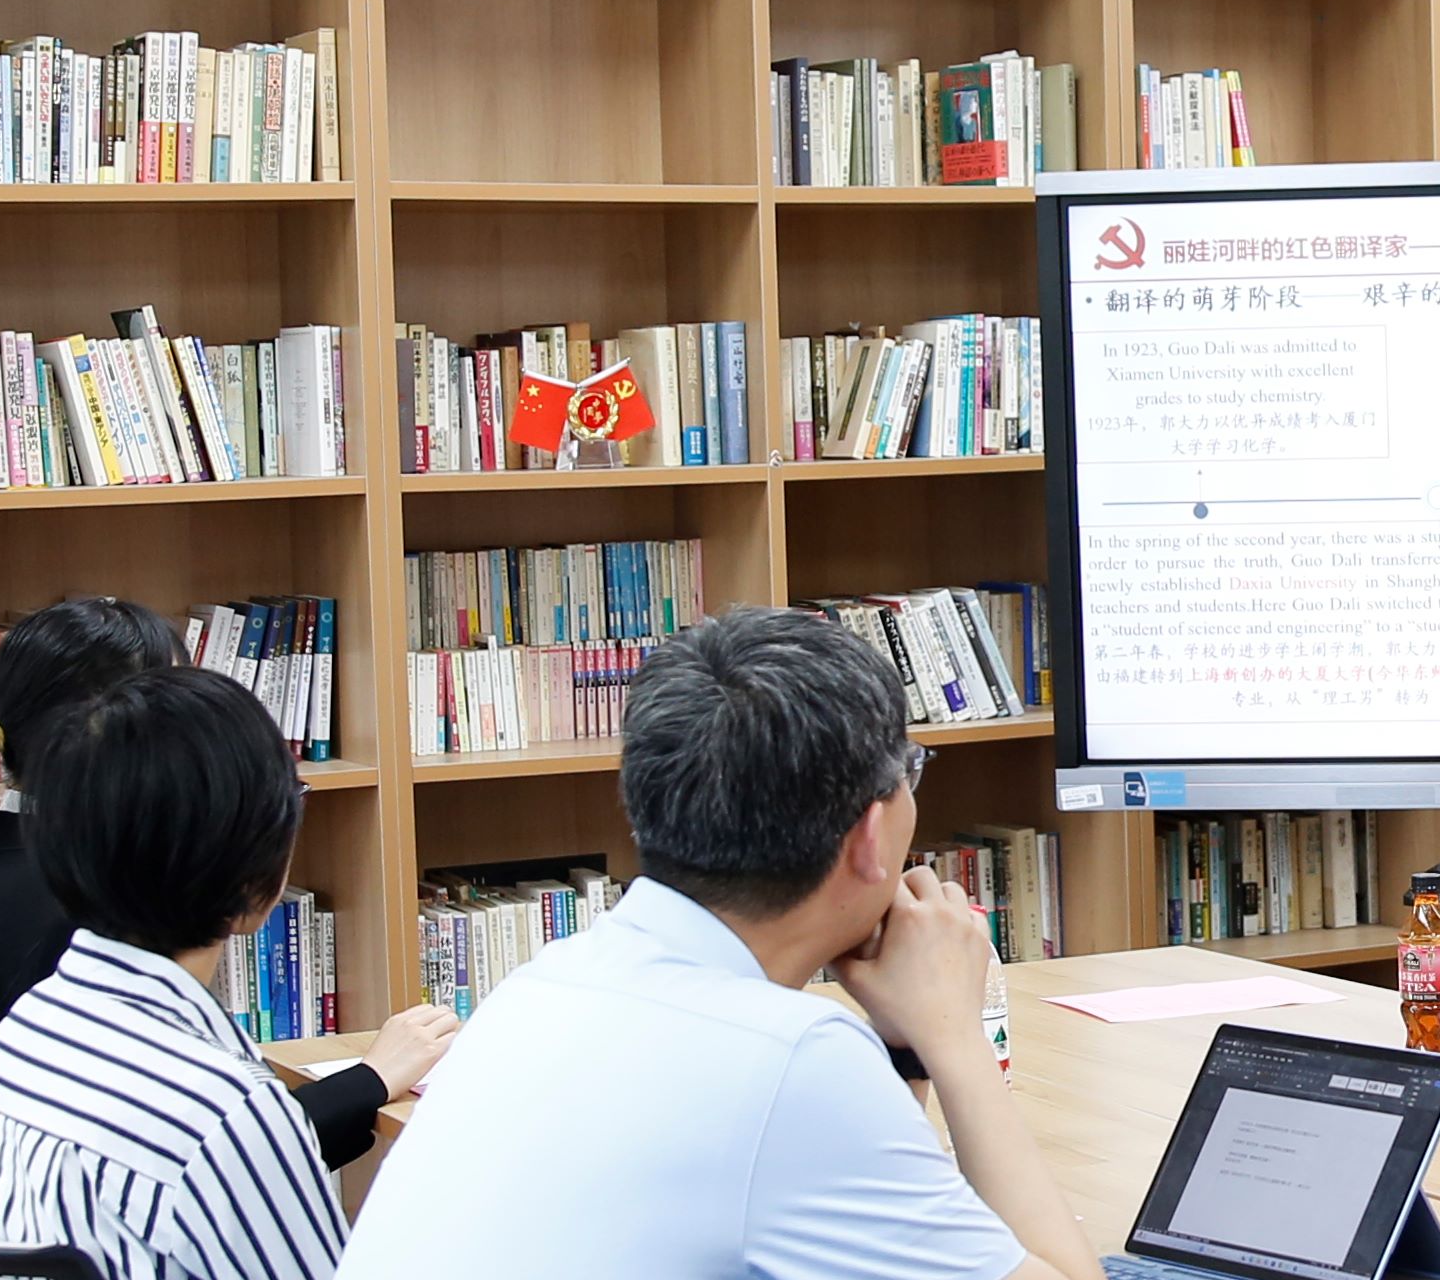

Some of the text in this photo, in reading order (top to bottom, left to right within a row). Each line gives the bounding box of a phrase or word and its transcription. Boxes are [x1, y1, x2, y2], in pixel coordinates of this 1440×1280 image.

[147, 67, 162, 121] 京都発見
[164, 67, 179, 121] 京都発見
[183, 67, 199, 122] 京都発見
[1188, 79, 1201, 132] 文献探索法
[1102, 336, 1357, 359] In 1923, Guo Dali was admitted to
[1105, 361, 1354, 383] Xiamen University with excellent
[5, 366, 20, 420] 京都発見
[1135, 387, 1326, 411] grades to study chemistry.
[1087, 532, 1104, 552] In
[1107, 532, 1131, 553] the
[1134, 532, 1182, 553] spring
[1185, 531, 1204, 548] of
[1206, 531, 1229, 547] the
[1233, 530, 1286, 547] second
[1289, 534, 1326, 550] year,
[1330, 529, 1368, 545] there
[1373, 532, 1403, 545] was
[1407, 532, 1416, 544] a
[1086, 554, 1128, 576] order
[1134, 556, 1150, 571] to
[1156, 557, 1206, 575] pursue
[1213, 552, 1236, 569] the
[1243, 552, 1283, 570] truth,
[1290, 552, 1323, 568] Guo
[1331, 550, 1362, 567] Dali
[1086, 576, 1134, 597] newly
[1140, 575, 1222, 593] established
[1229, 575, 1273, 591] Daxia
[1280, 574, 1355, 592] University
[1364, 573, 1379, 589] in
[1089, 598, 1150, 618] teachers
[1154, 597, 1182, 617] and
[1186, 596, 1287, 614] students.Here
[1291, 595, 1324, 612] Guo
[1329, 594, 1361, 611] Dali
[1367, 594, 1432, 611] switched
